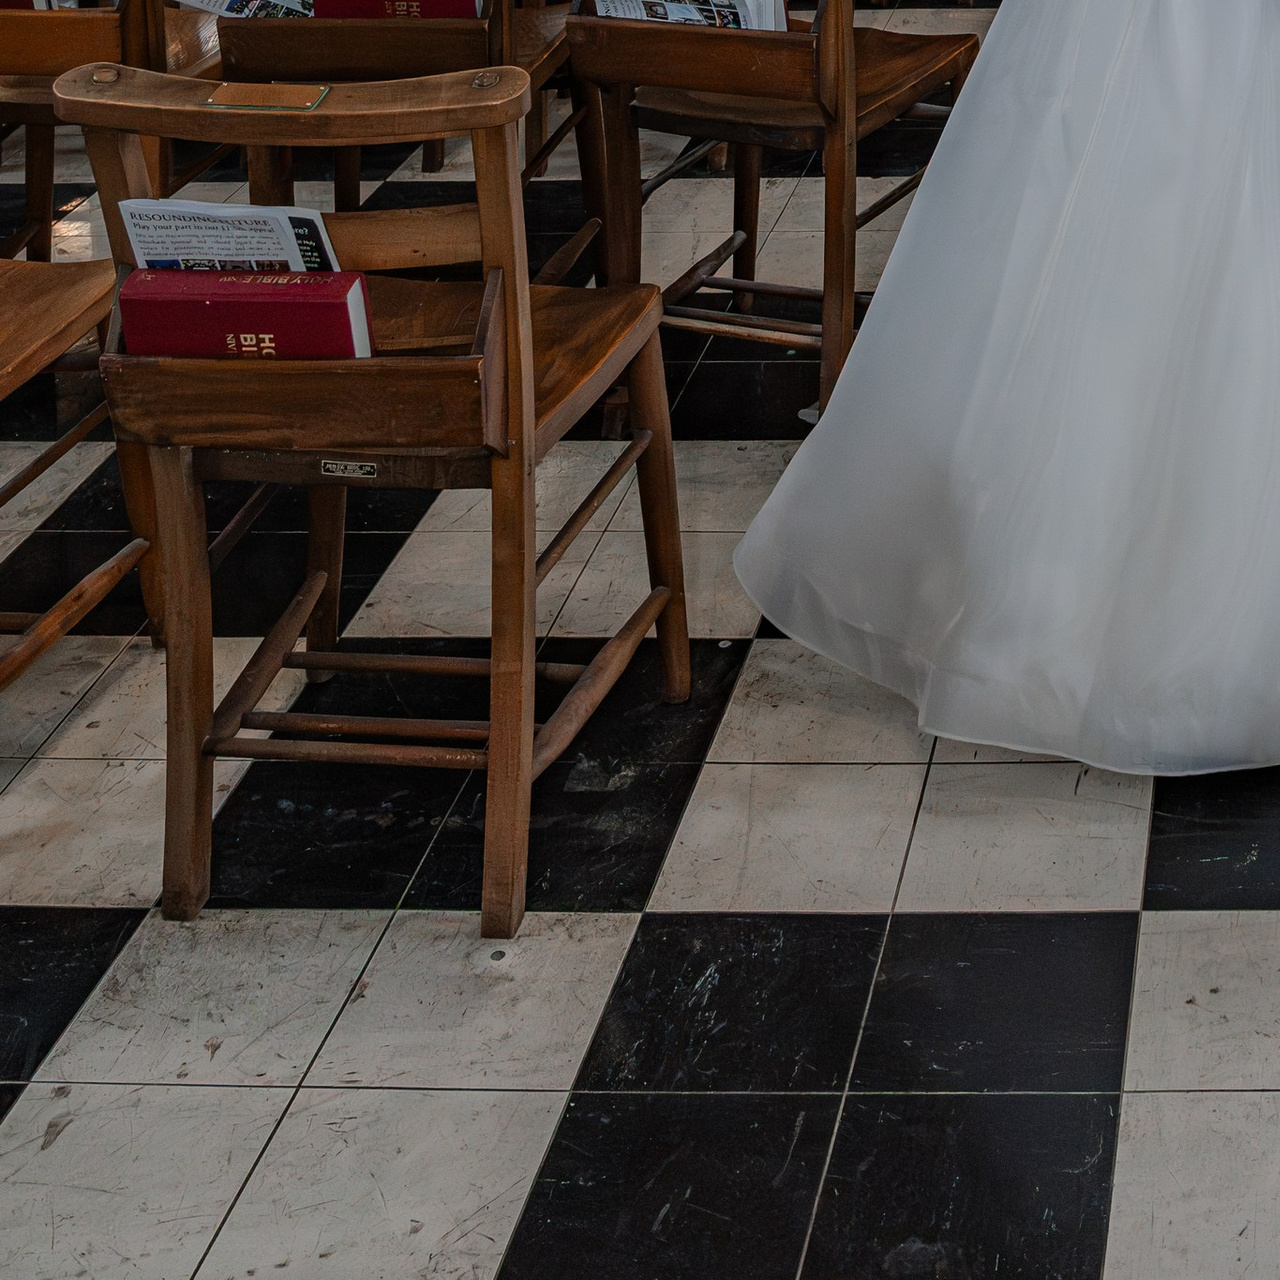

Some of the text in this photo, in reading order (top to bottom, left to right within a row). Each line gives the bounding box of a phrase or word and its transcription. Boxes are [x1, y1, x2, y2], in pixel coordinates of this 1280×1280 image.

[129, 211, 219, 224] RESOUNDING
[132, 222, 150, 231] Play
[152, 223, 173, 231] your
[174, 223, 192, 232] part
[241, 276, 289, 284] BIBLE
[289, 275, 335, 285] HOLY
